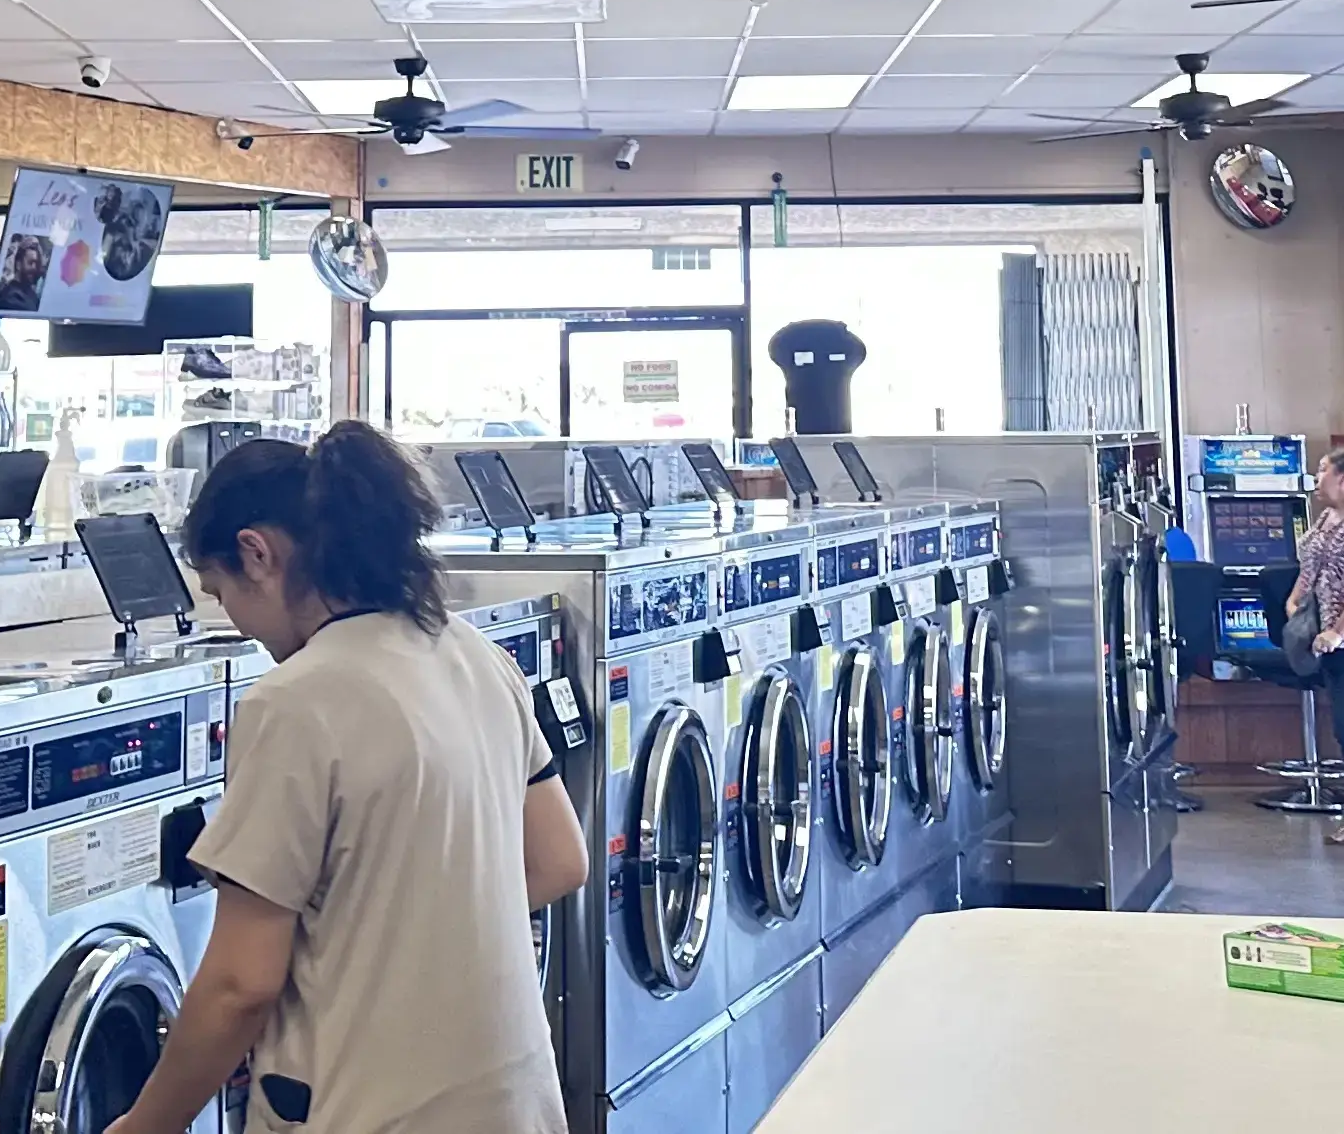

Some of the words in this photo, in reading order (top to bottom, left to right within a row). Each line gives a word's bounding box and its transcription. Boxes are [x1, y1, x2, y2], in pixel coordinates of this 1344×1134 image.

[529, 156, 574, 188] EXIT
[631, 364, 644, 372] NO
[86, 792, 120, 810] DEXTER
